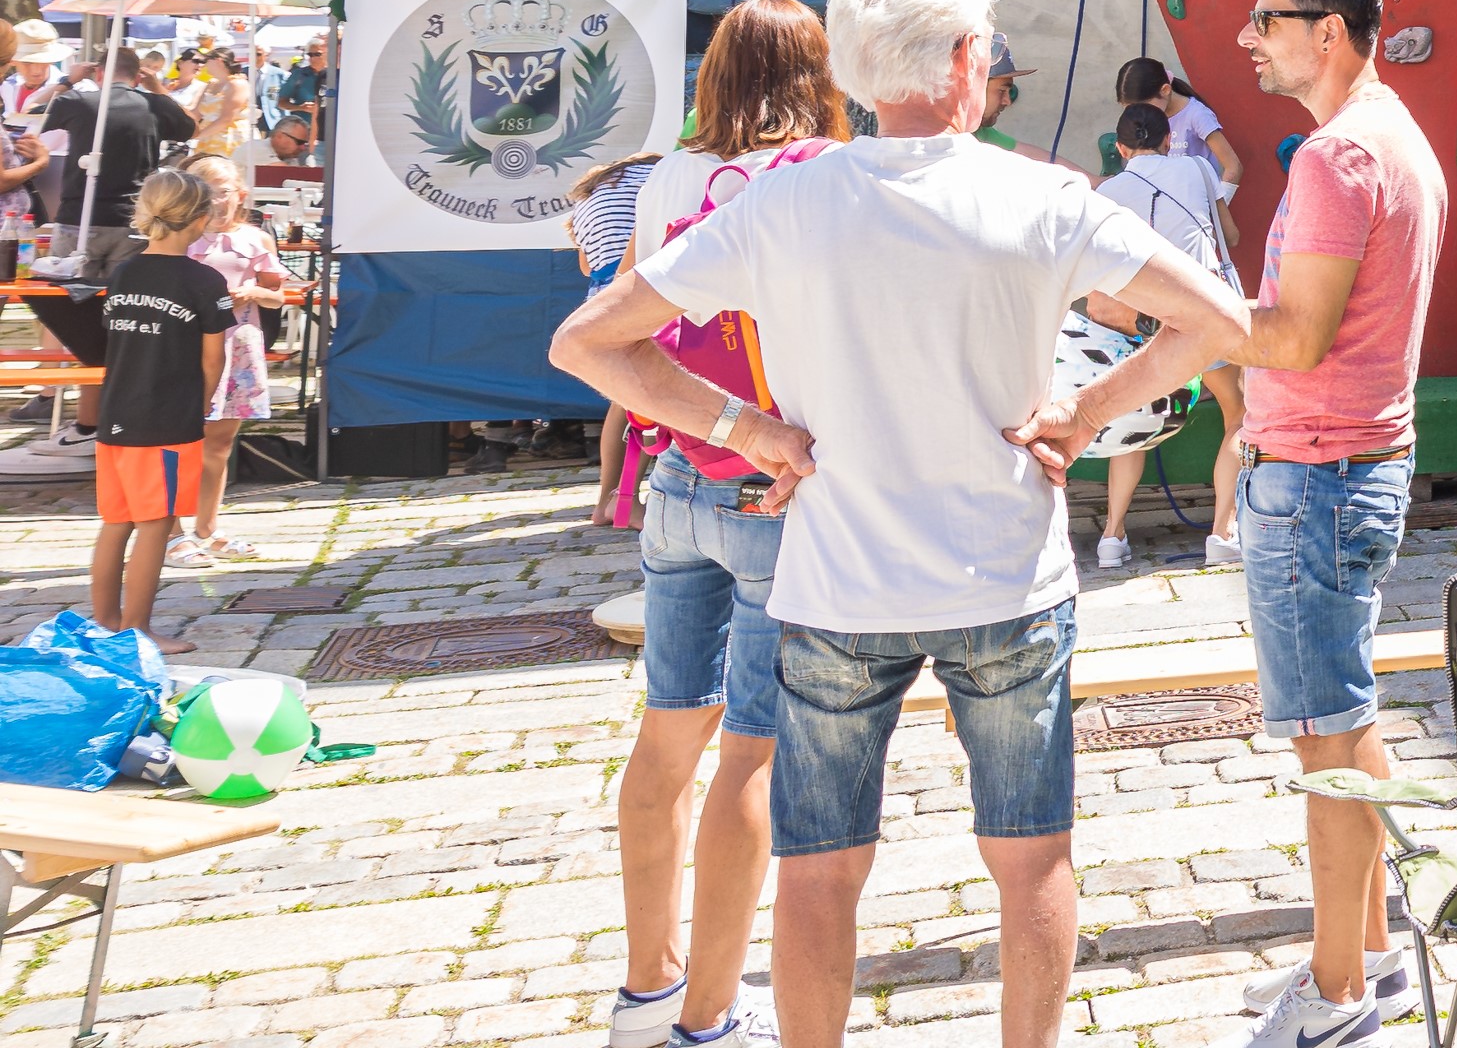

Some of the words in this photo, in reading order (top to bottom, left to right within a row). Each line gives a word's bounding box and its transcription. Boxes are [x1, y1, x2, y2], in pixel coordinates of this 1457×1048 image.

[498, 117, 534, 132] 1881
[405, 163, 499, 221] Trauneck
[109, 293, 197, 323] TRAUNSTEIN
